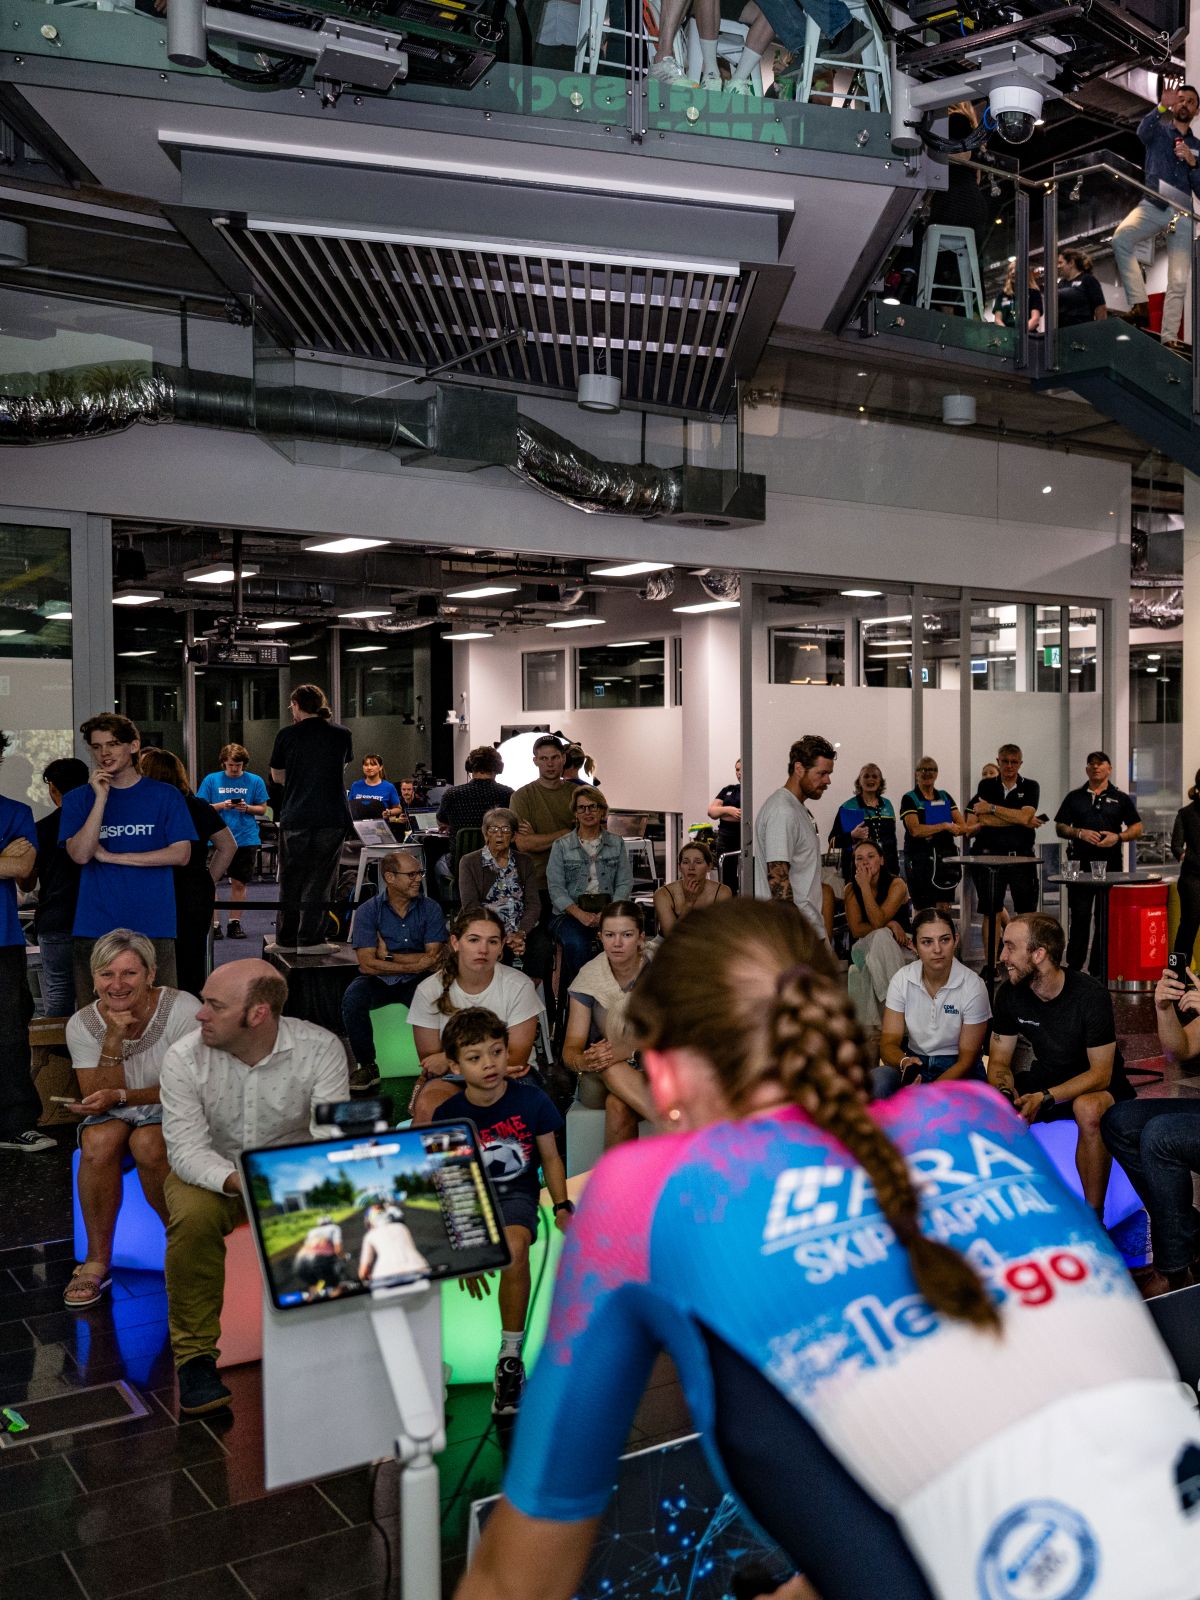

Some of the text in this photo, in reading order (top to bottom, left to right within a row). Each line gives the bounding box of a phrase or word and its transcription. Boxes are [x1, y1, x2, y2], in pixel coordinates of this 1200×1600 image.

[225, 787, 249, 795] SPORT
[107, 824, 155, 838] SPORT
[793, 1181, 1059, 1285] SKIP APITAL
